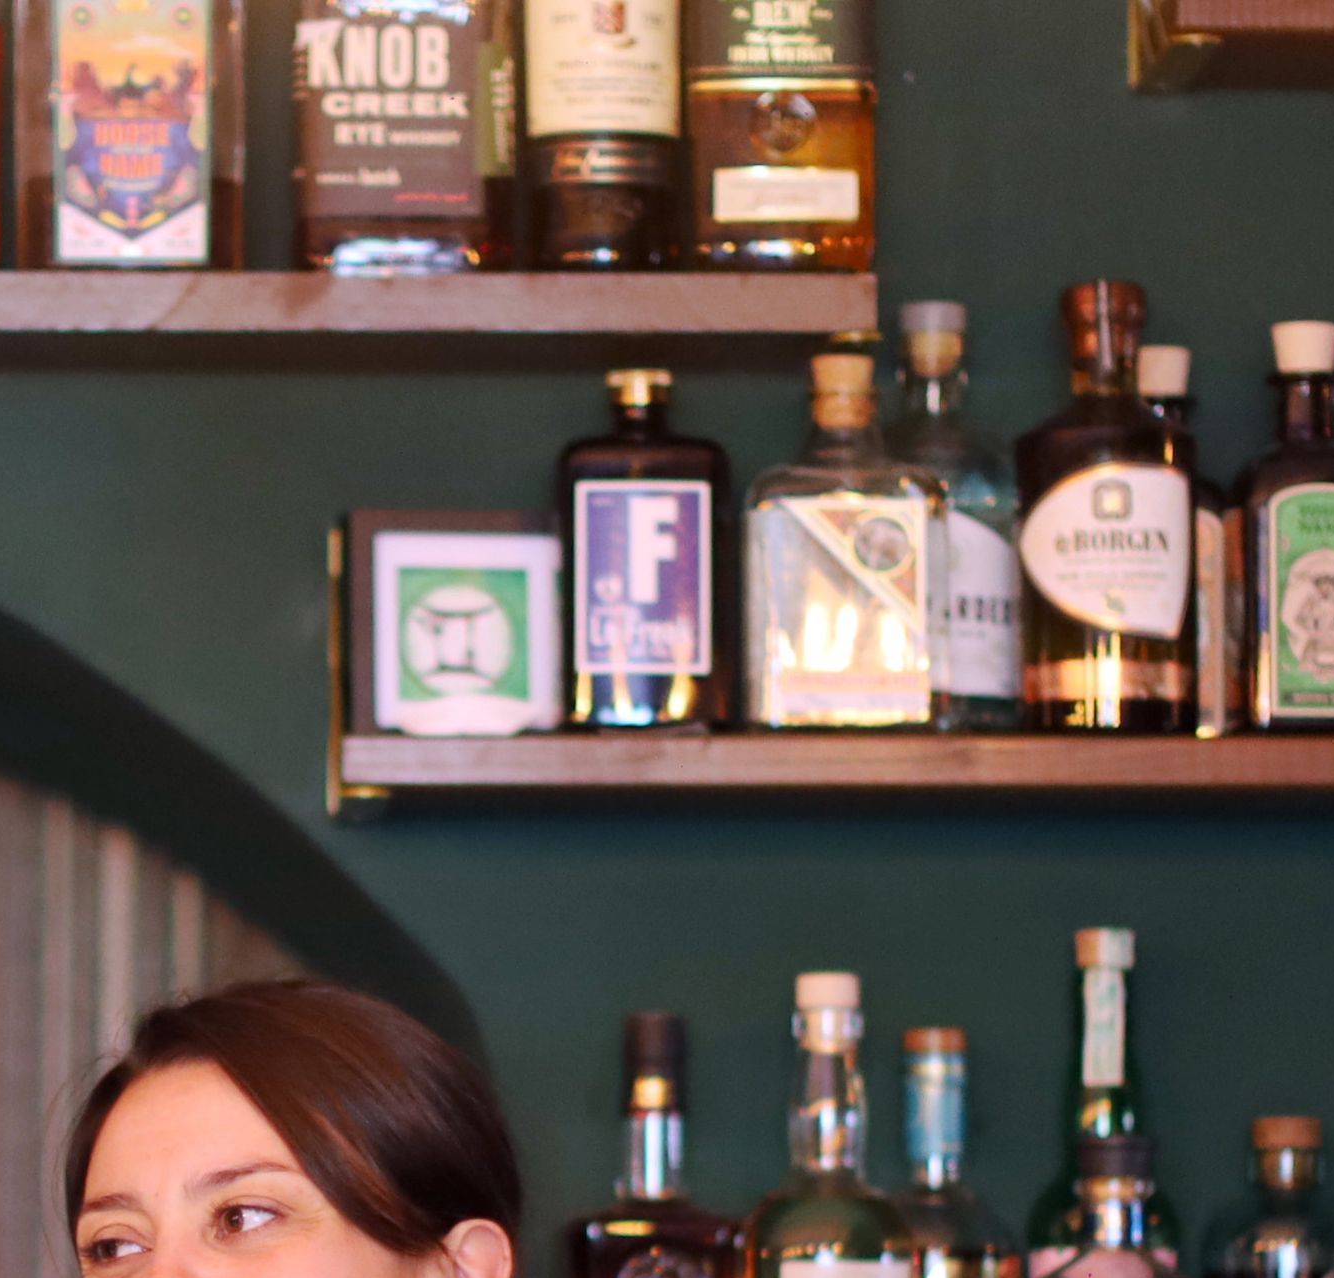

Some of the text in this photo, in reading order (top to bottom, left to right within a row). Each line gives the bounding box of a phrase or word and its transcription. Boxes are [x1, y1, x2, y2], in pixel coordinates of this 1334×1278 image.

[307, 22, 451, 88] KNOB
[321, 91, 469, 119] CREEK
[334, 121, 387, 146] RYE
